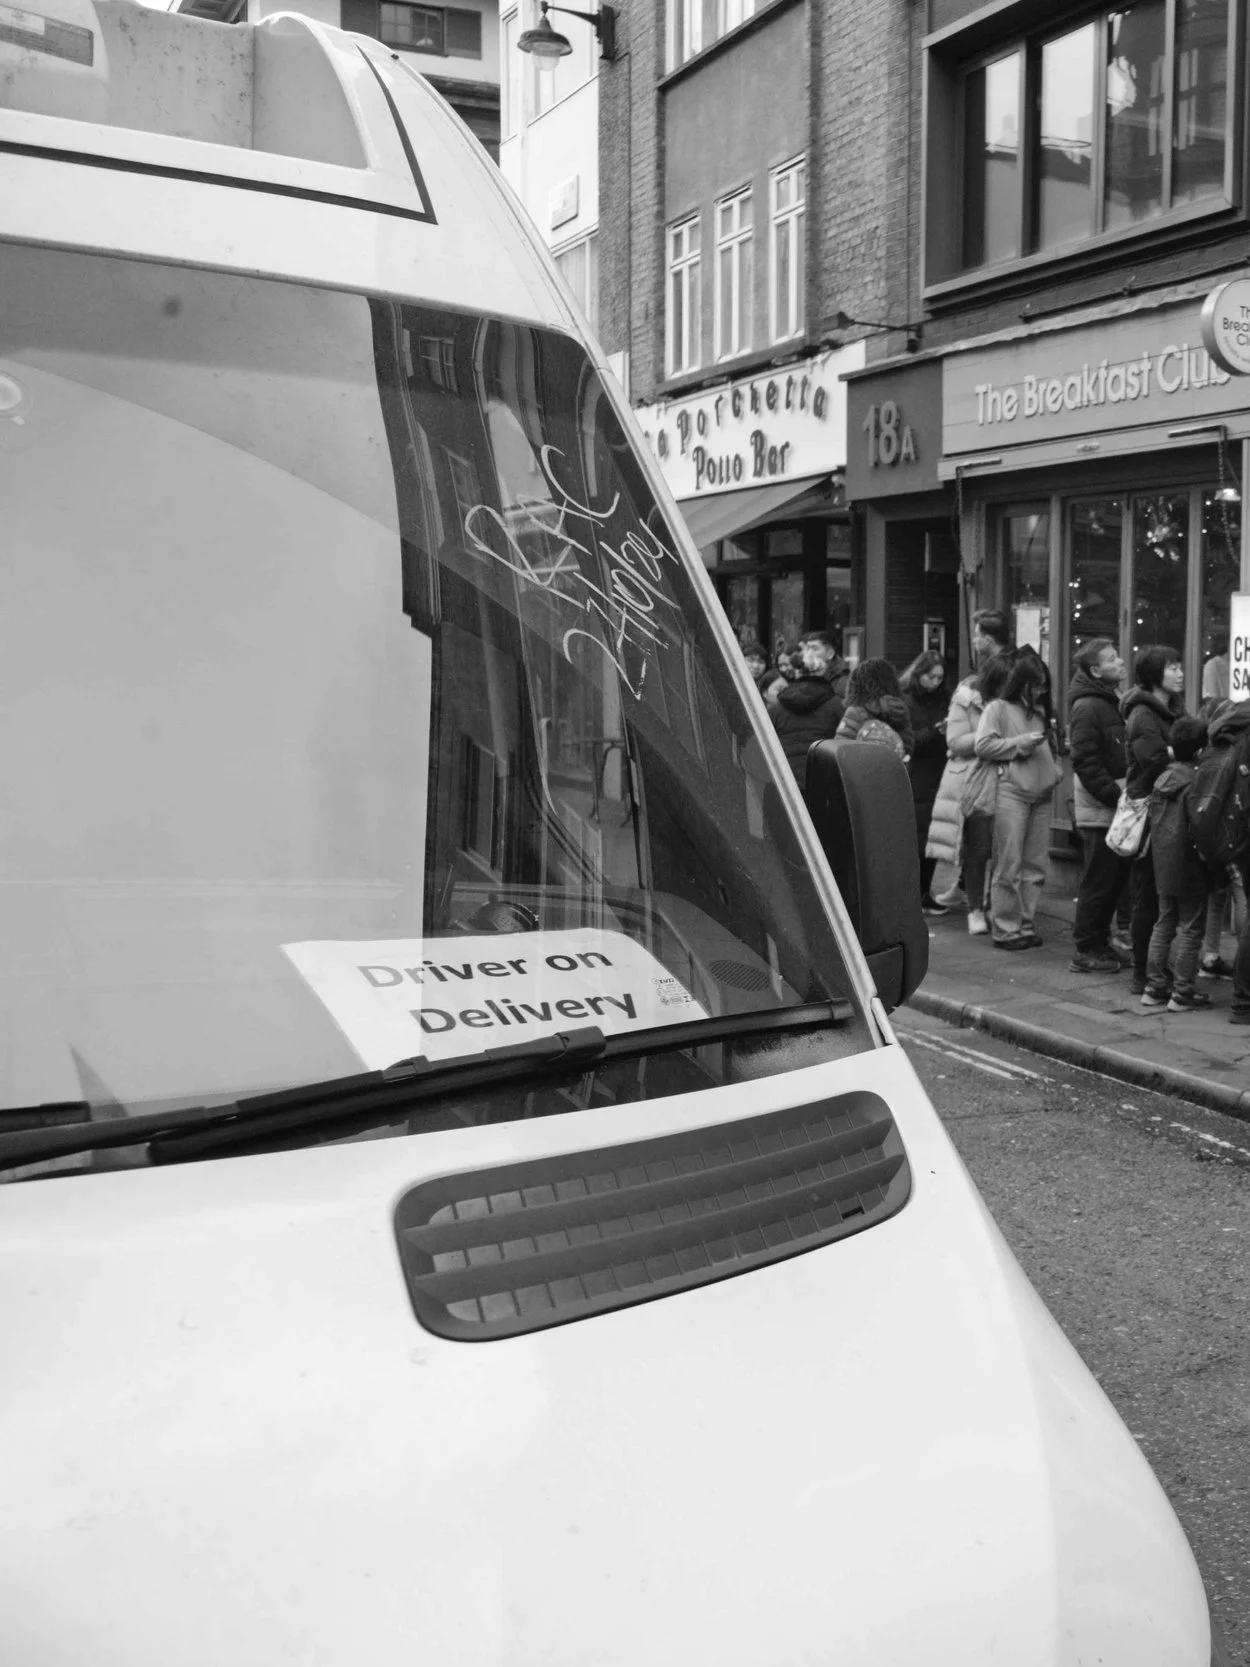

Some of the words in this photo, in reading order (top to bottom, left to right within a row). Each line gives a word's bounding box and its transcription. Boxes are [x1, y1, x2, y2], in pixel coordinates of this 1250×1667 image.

[974, 383, 1019, 425] The
[1023, 350, 1152, 417] Breakfast
[750, 429, 791, 478] Bar
[862, 400, 917, 467] 18A
[357, 958, 528, 988] Driver
[545, 951, 614, 972] on
[409, 993, 638, 1034] Delivery
